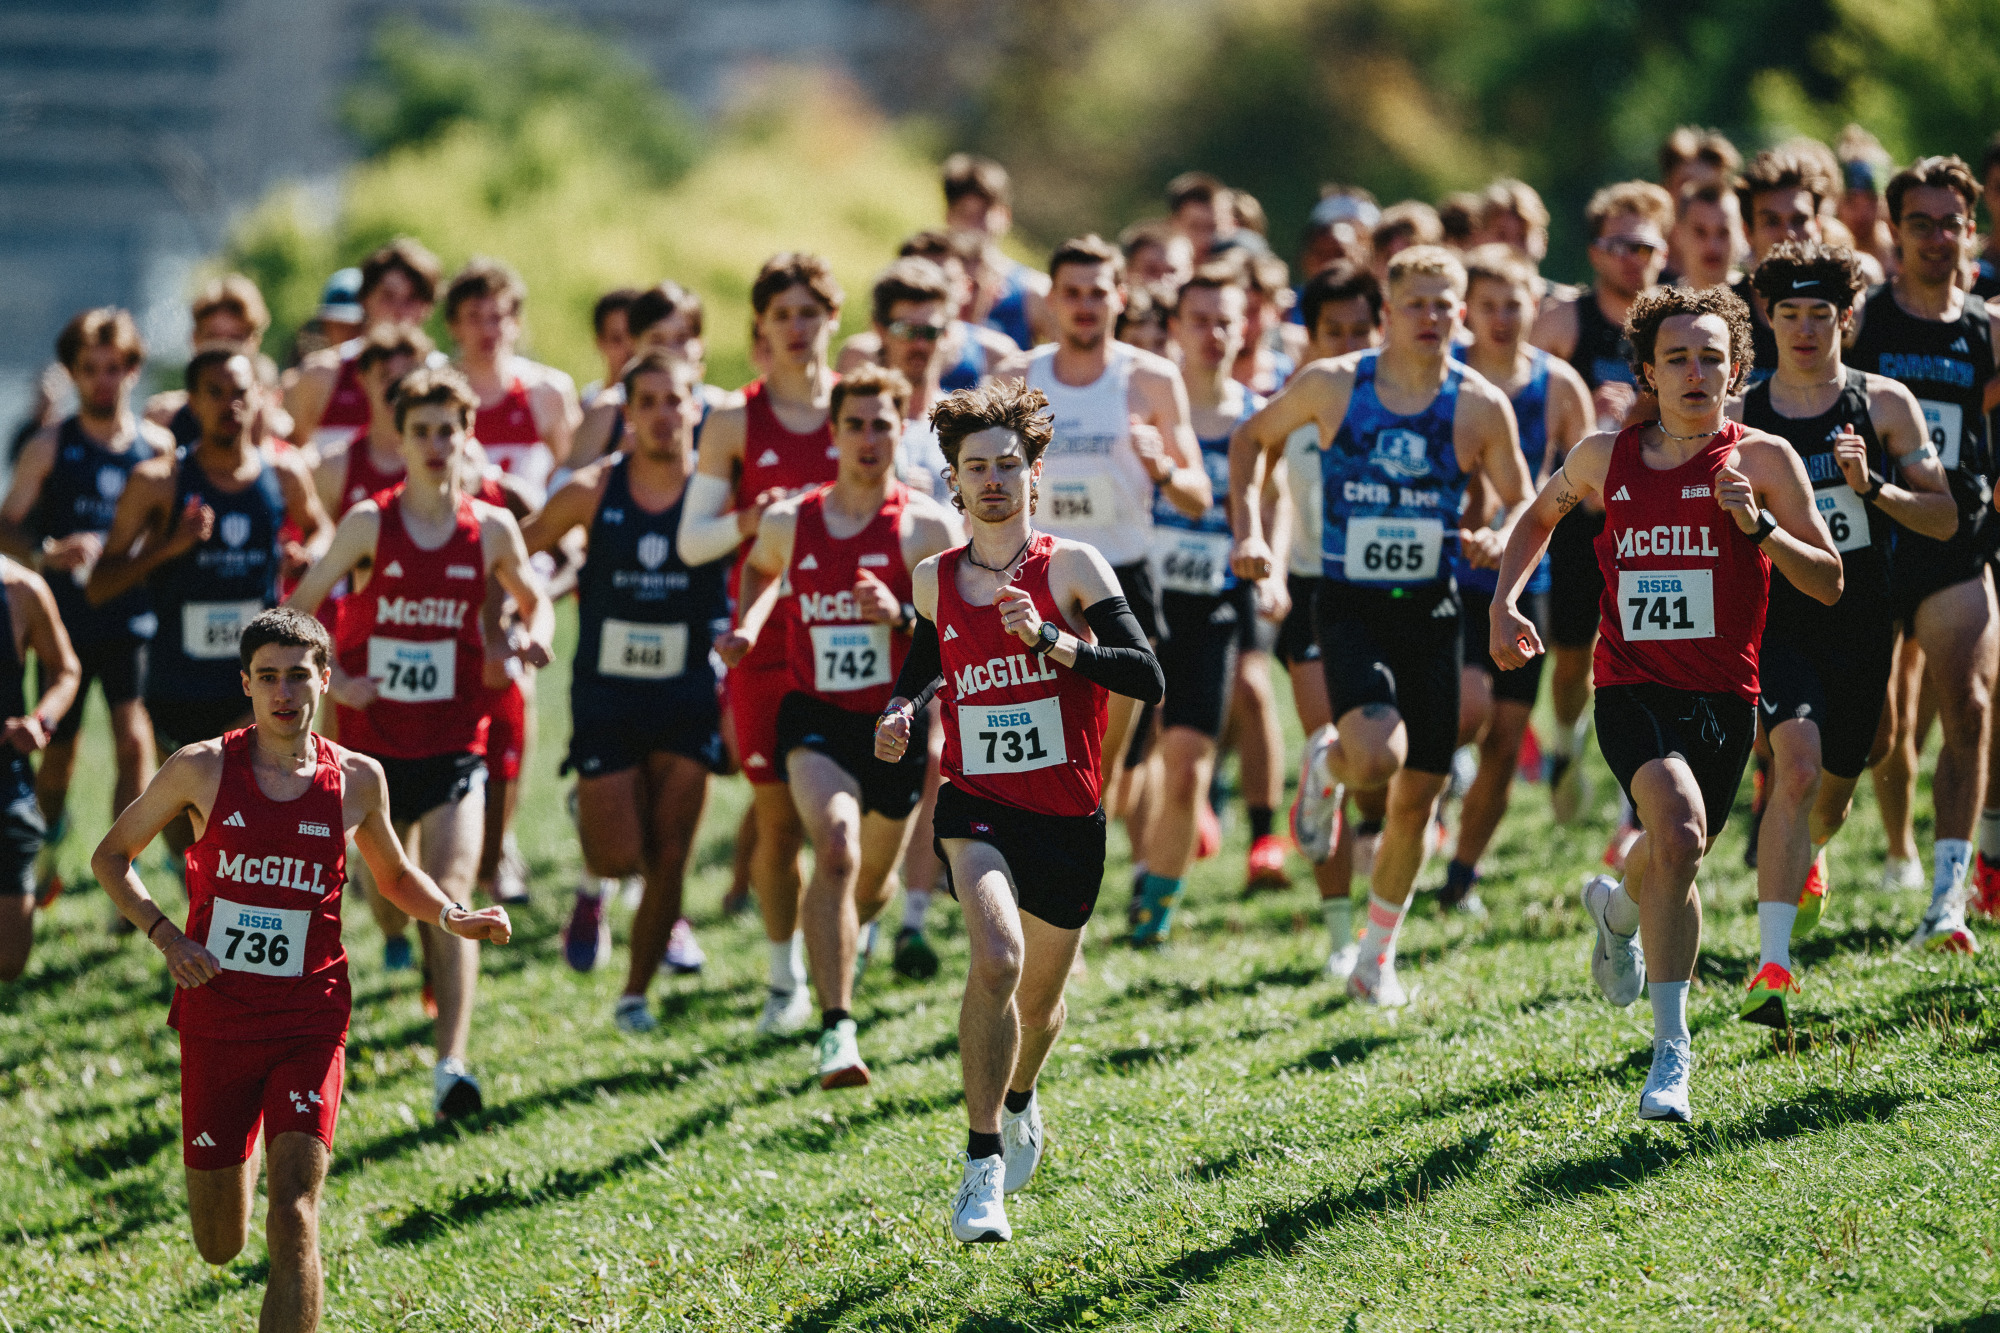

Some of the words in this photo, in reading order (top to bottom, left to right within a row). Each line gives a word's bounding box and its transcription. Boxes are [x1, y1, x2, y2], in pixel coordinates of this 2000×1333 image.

[1343, 480, 1391, 504] CMR
[1681, 487, 1712, 499] RSEQ
[1364, 542, 1424, 572] 665
[1613, 525, 1719, 559] McGILL
[1637, 579, 1683, 593] RSEQ
[376, 595, 469, 629] McGILL
[1628, 596, 1694, 630] 741
[387, 662, 438, 692] 740
[824, 651, 877, 680] 742
[954, 652, 1058, 700] McGILL
[986, 711, 1032, 727] RSEQ
[979, 727, 1047, 763] 731
[298, 823, 331, 837] RSEQ
[216, 850, 326, 895] McGILL
[238, 913, 283, 930] RSEQ
[224, 928, 289, 966] 736
